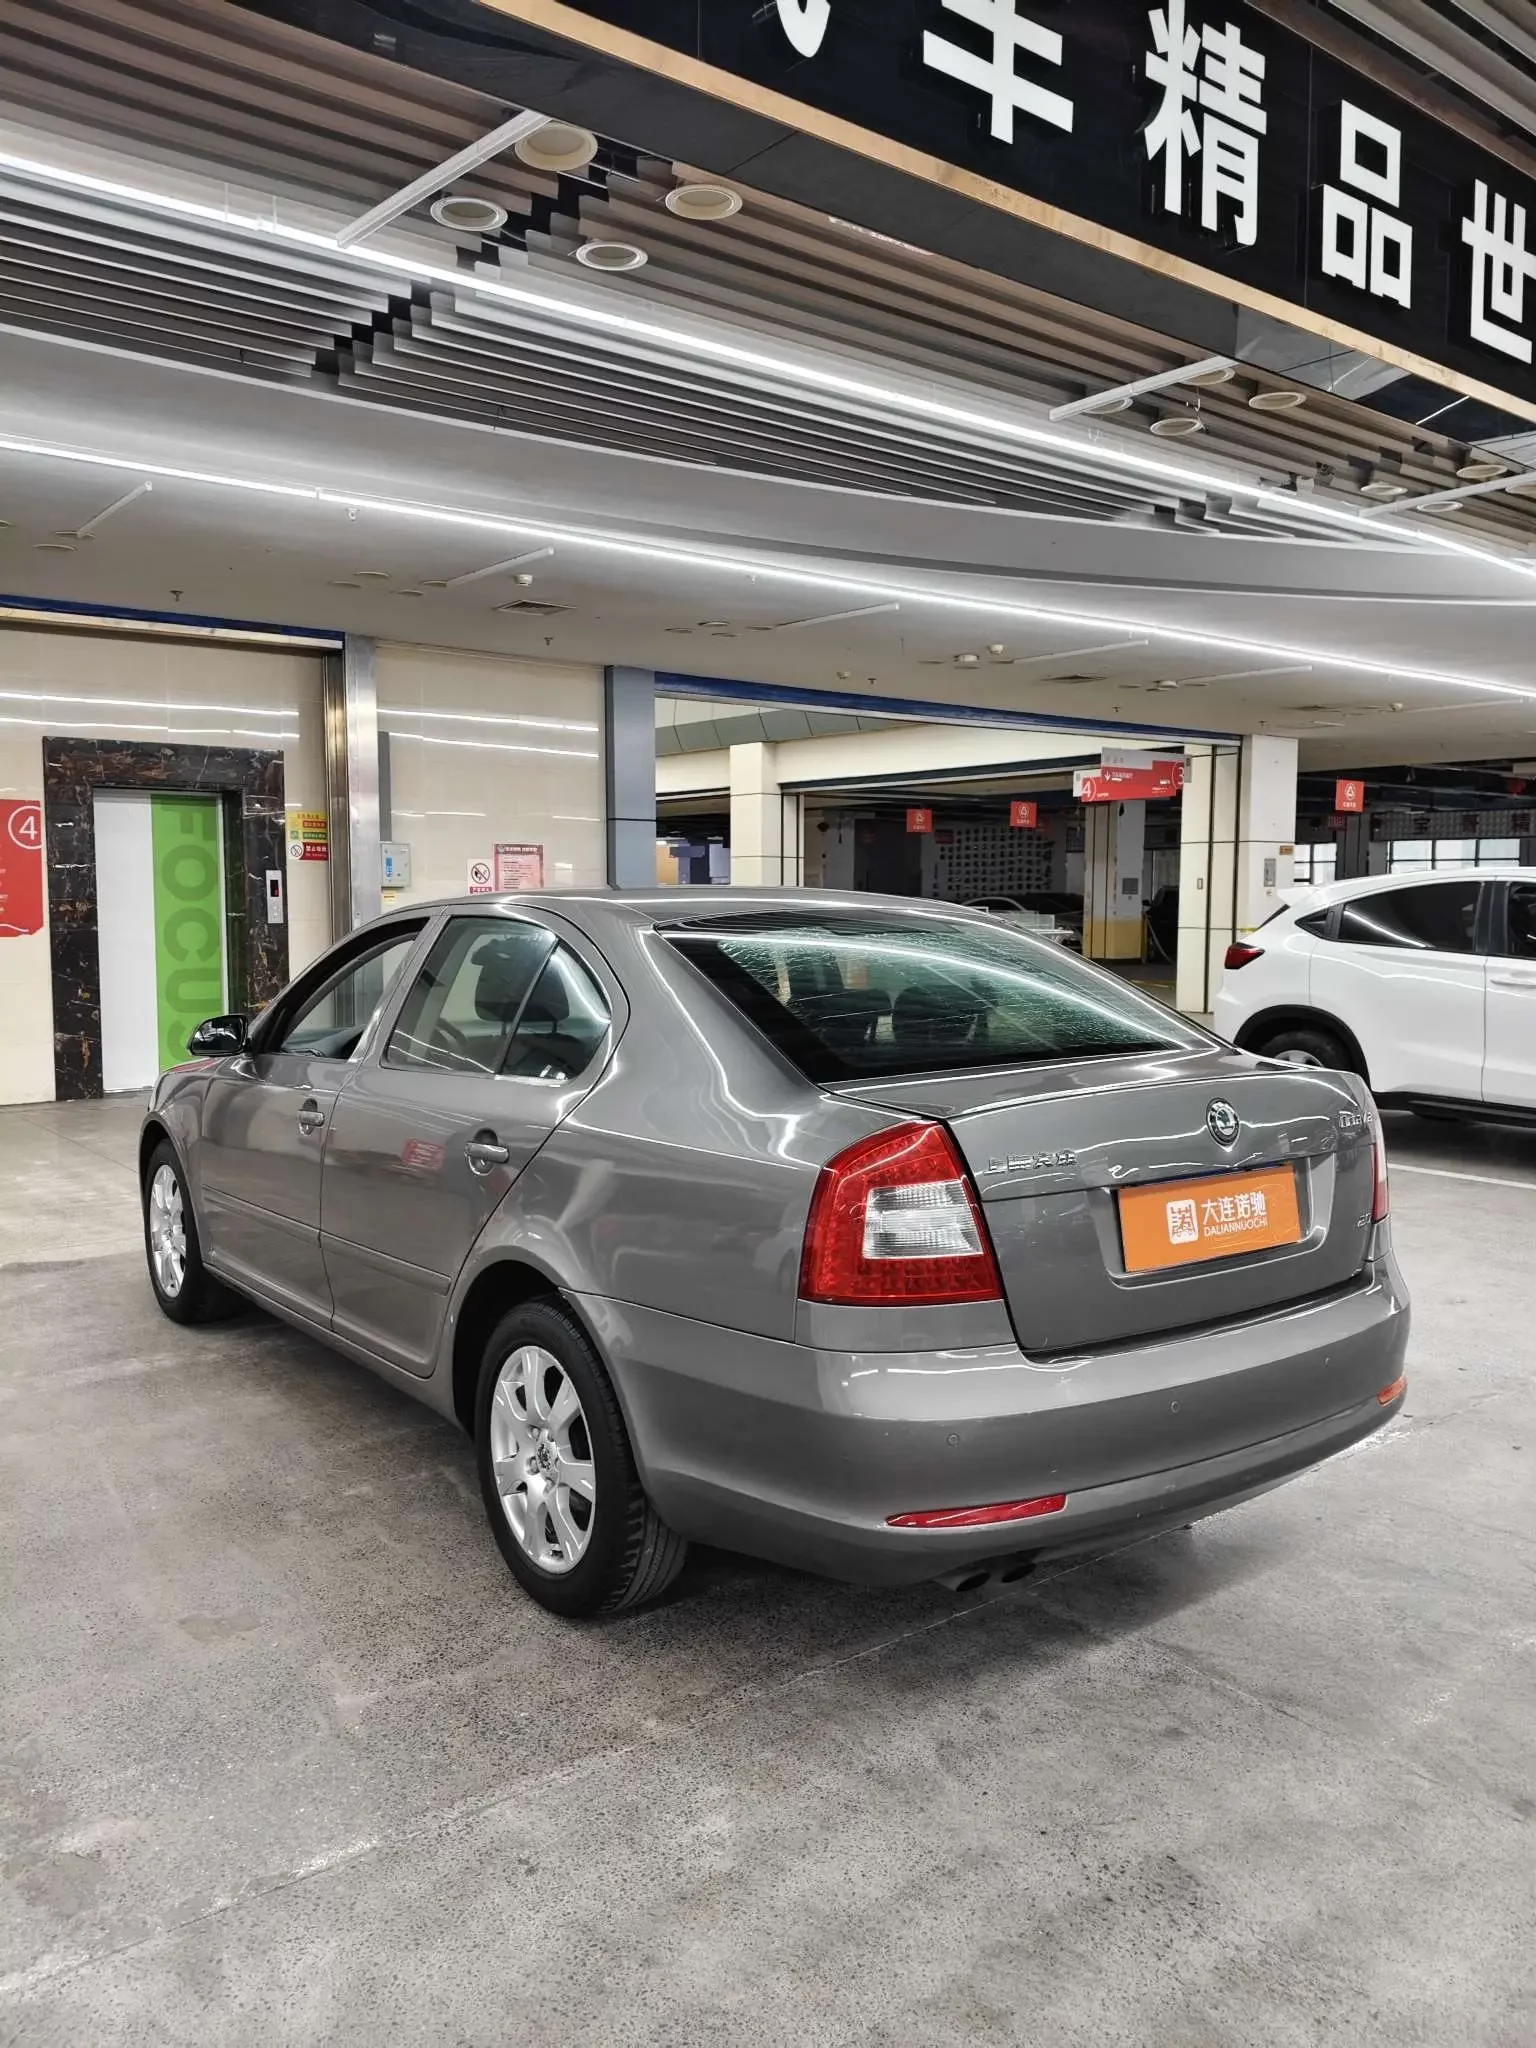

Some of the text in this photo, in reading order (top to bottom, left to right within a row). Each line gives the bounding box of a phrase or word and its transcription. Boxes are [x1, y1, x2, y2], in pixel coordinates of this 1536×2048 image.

[775, 0, 1536, 364] 车精品世
[1082, 780, 1092, 798] 4
[19, 815, 38, 840] 4
[1200, 1190, 1267, 1226] 大连诺驰
[1203, 1217, 1268, 1238] DALIANNUOCHI
